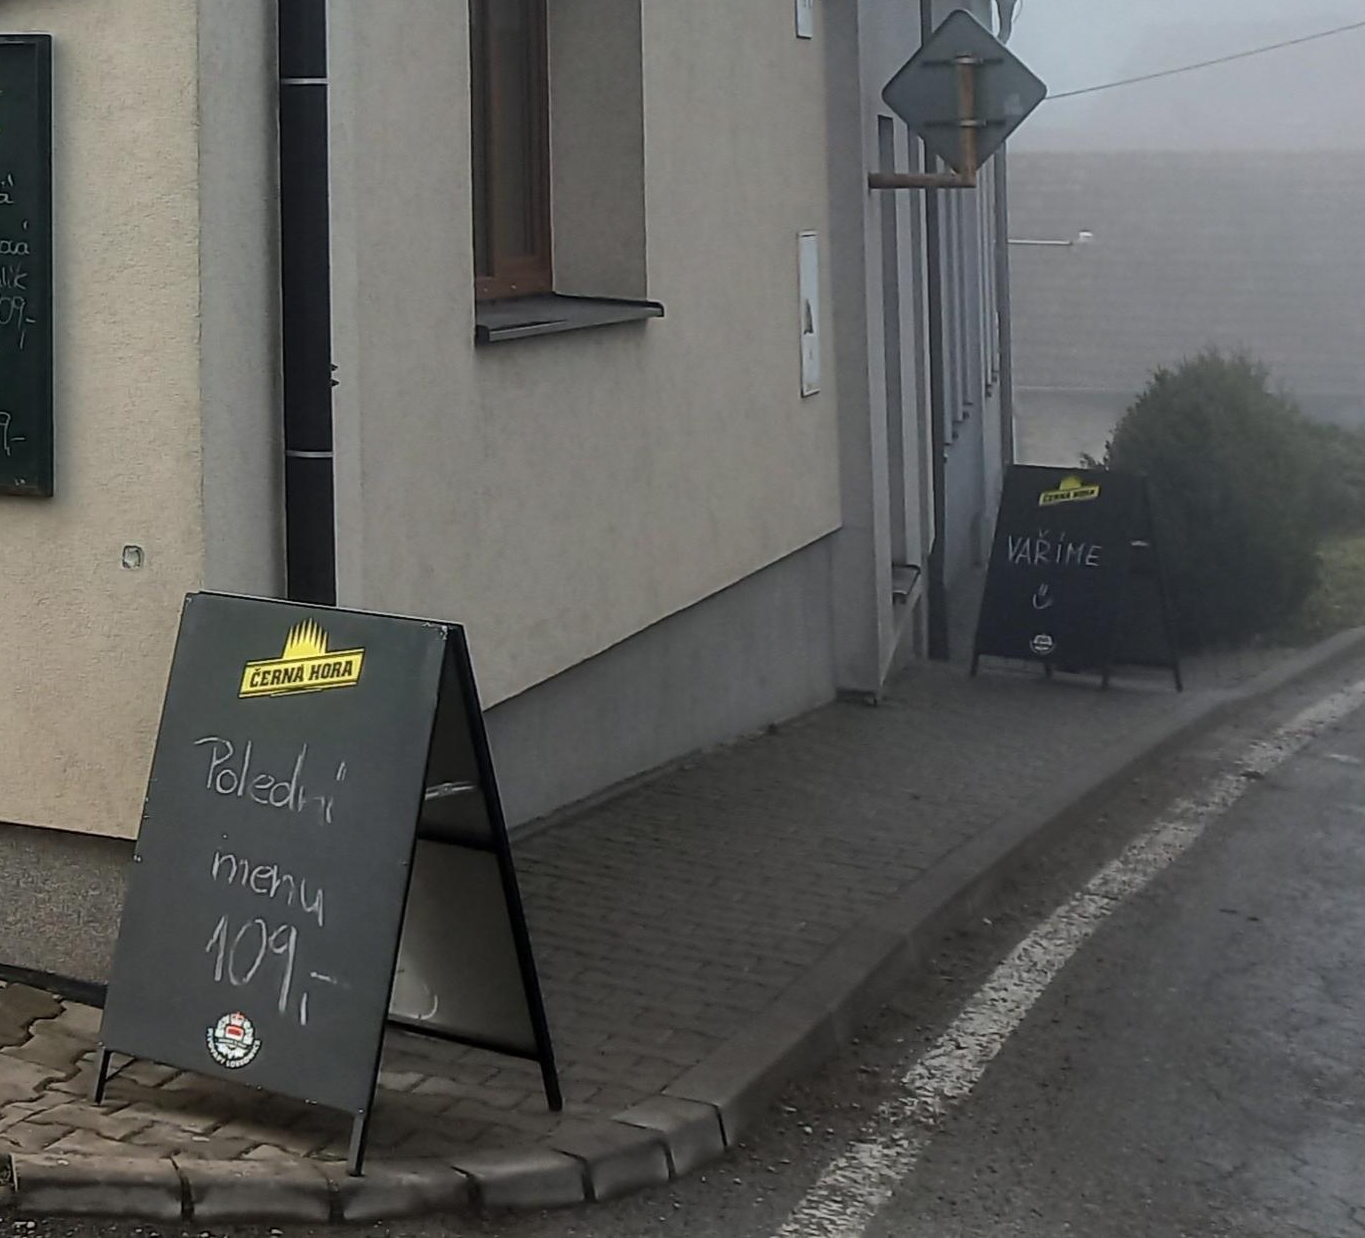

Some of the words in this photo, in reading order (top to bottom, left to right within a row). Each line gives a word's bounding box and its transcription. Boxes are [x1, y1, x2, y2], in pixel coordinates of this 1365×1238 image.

[1007, 528, 1103, 567] VAŘÍME
[249, 663, 305, 689] ČERNÁ
[308, 659, 354, 681] HORA
[209, 846, 326, 928] menu
